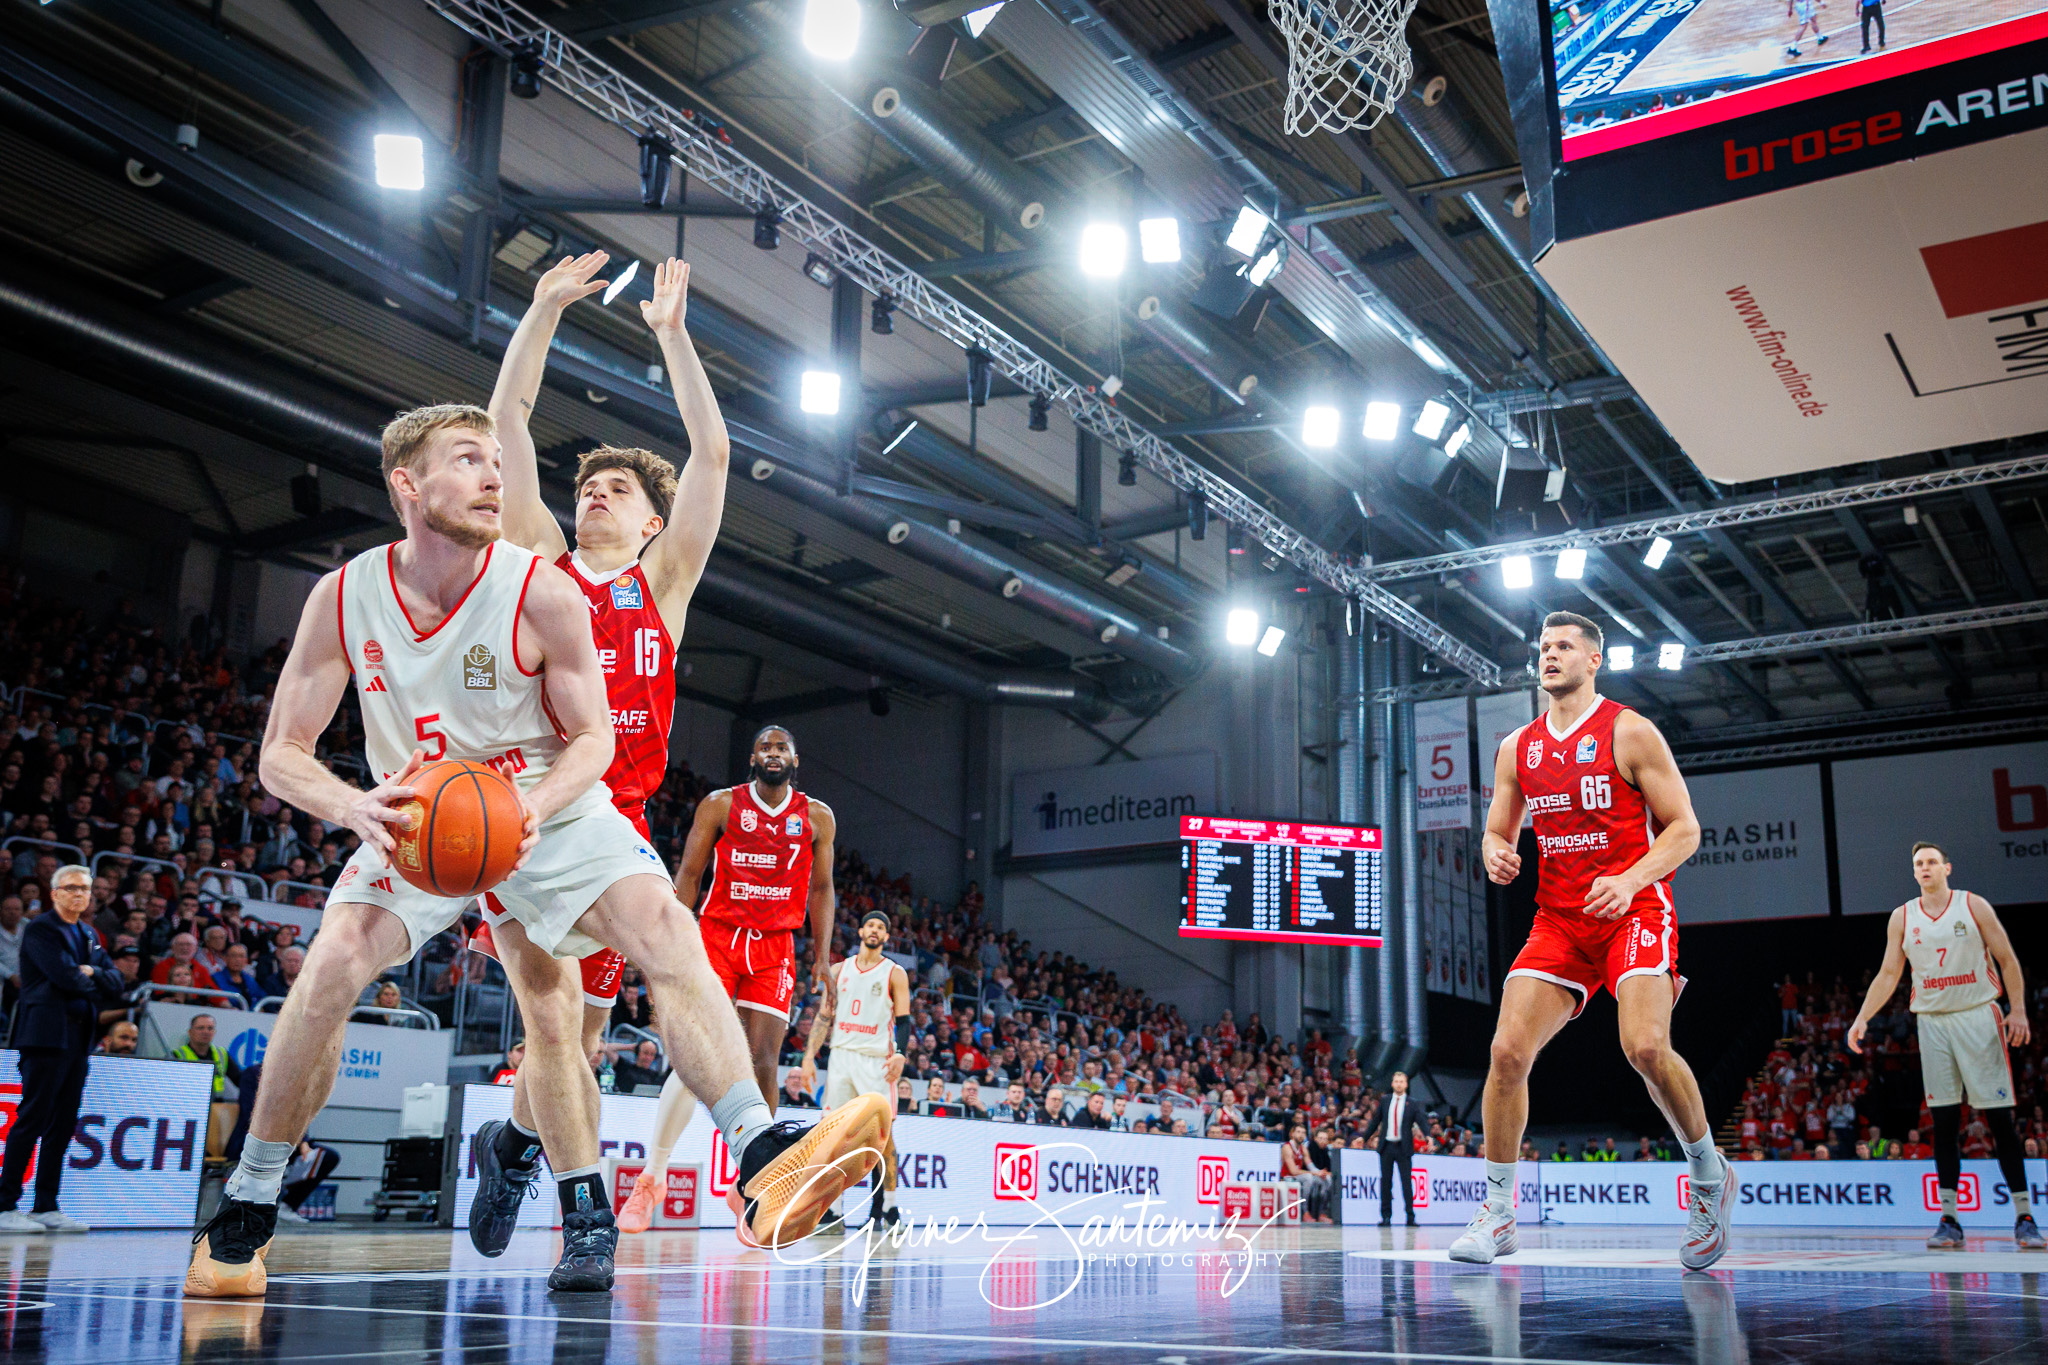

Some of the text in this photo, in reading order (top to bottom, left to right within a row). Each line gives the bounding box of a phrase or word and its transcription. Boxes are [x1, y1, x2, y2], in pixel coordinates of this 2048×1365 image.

[1724, 110, 1903, 181] brose
[1726, 285, 1828, 417] www.fim-online.de
[618, 597, 639, 606] BBL
[634, 628, 661, 677] 15
[467, 677, 493, 687] BBL
[415, 713, 447, 762] 5
[1431, 744, 1454, 781] 5
[1418, 784, 1468, 798] brose
[1525, 793, 1571, 811] brose
[1580, 775, 1612, 810] 65
[1418, 796, 1469, 810] baskets
[1188, 818, 1203, 830] 27
[1361, 830, 1376, 842] 24
[1547, 832, 1609, 849] PRIOSAFE
[731, 848, 777, 864] brose
[787, 844, 801, 870] 7
[1742, 846, 1798, 862] GMBH
[749, 885, 792, 897] PRIOSAFE
[1936, 947, 1947, 967] 7
[1923, 969, 1977, 991] siegmund
[851, 999, 861, 1016] 0
[69, 1115, 197, 1171] SCH
[1000, 1153, 1160, 1196] DB SCHENKER
[1433, 1179, 1488, 1202] SCHENKER
[1545, 1184, 1650, 1204] HENKER
[1740, 1183, 1895, 1205] SCHENKER
